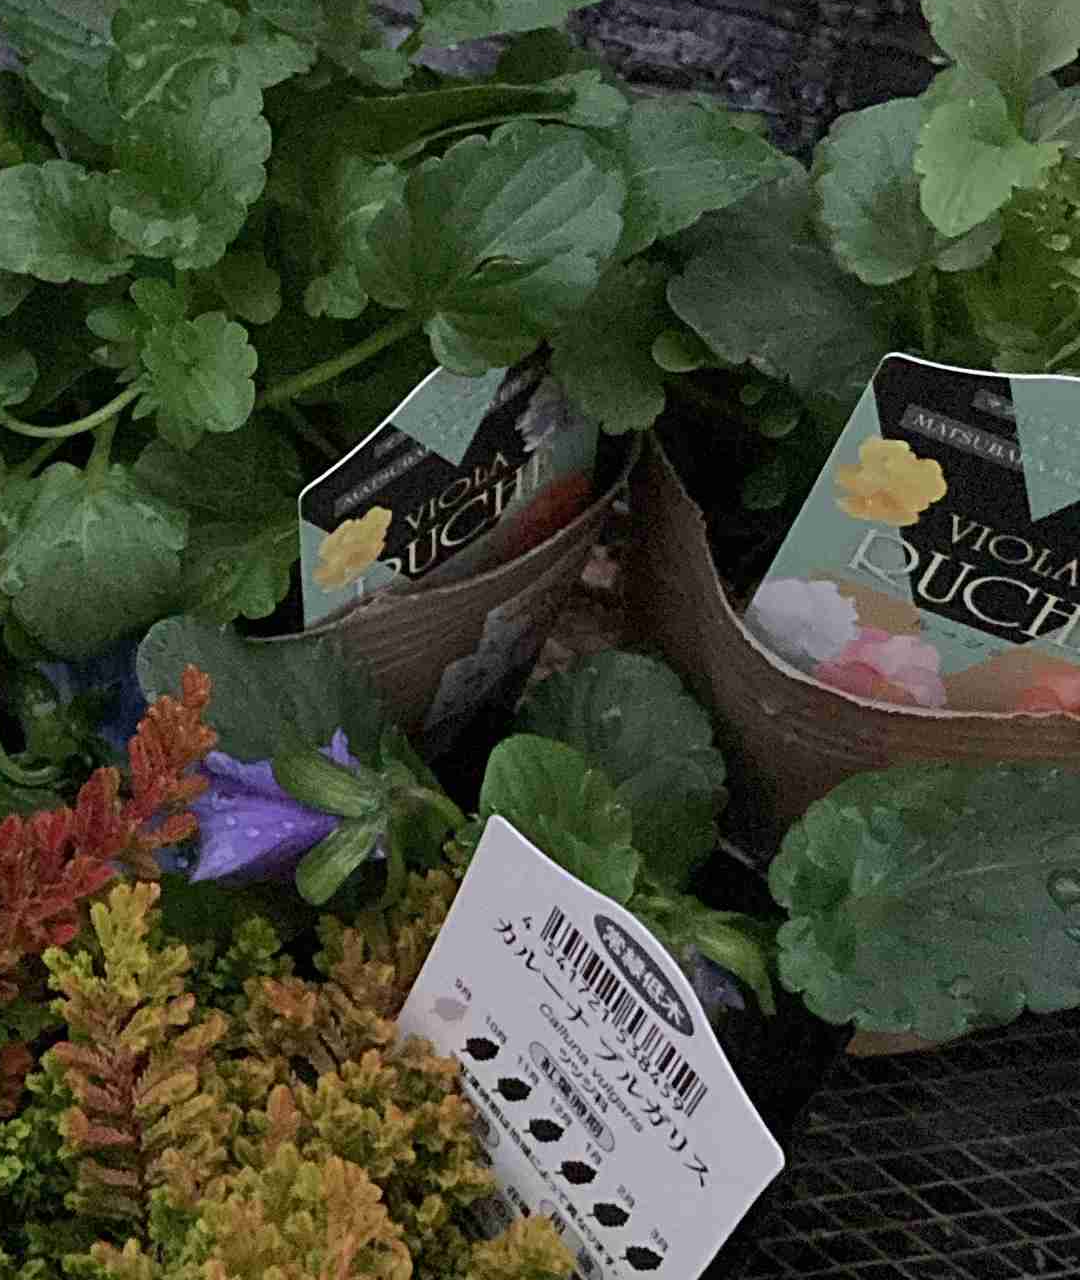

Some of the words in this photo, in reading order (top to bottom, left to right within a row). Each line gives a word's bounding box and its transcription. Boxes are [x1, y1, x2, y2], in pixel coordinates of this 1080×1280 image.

[405, 452, 508, 530] VIOLA
[949, 514, 1080, 587] VIOLA
[493, 918, 590, 1029] カルーナ
[522, 916, 533, 930] 4
[544, 942, 611, 1024] 541721
[616, 1031, 684, 1111] 538459
[602, 923, 683, 1025] 常緑低木
[539, 1002, 590, 1066] Calluna
[592, 1068, 644, 1134] vulgaris
